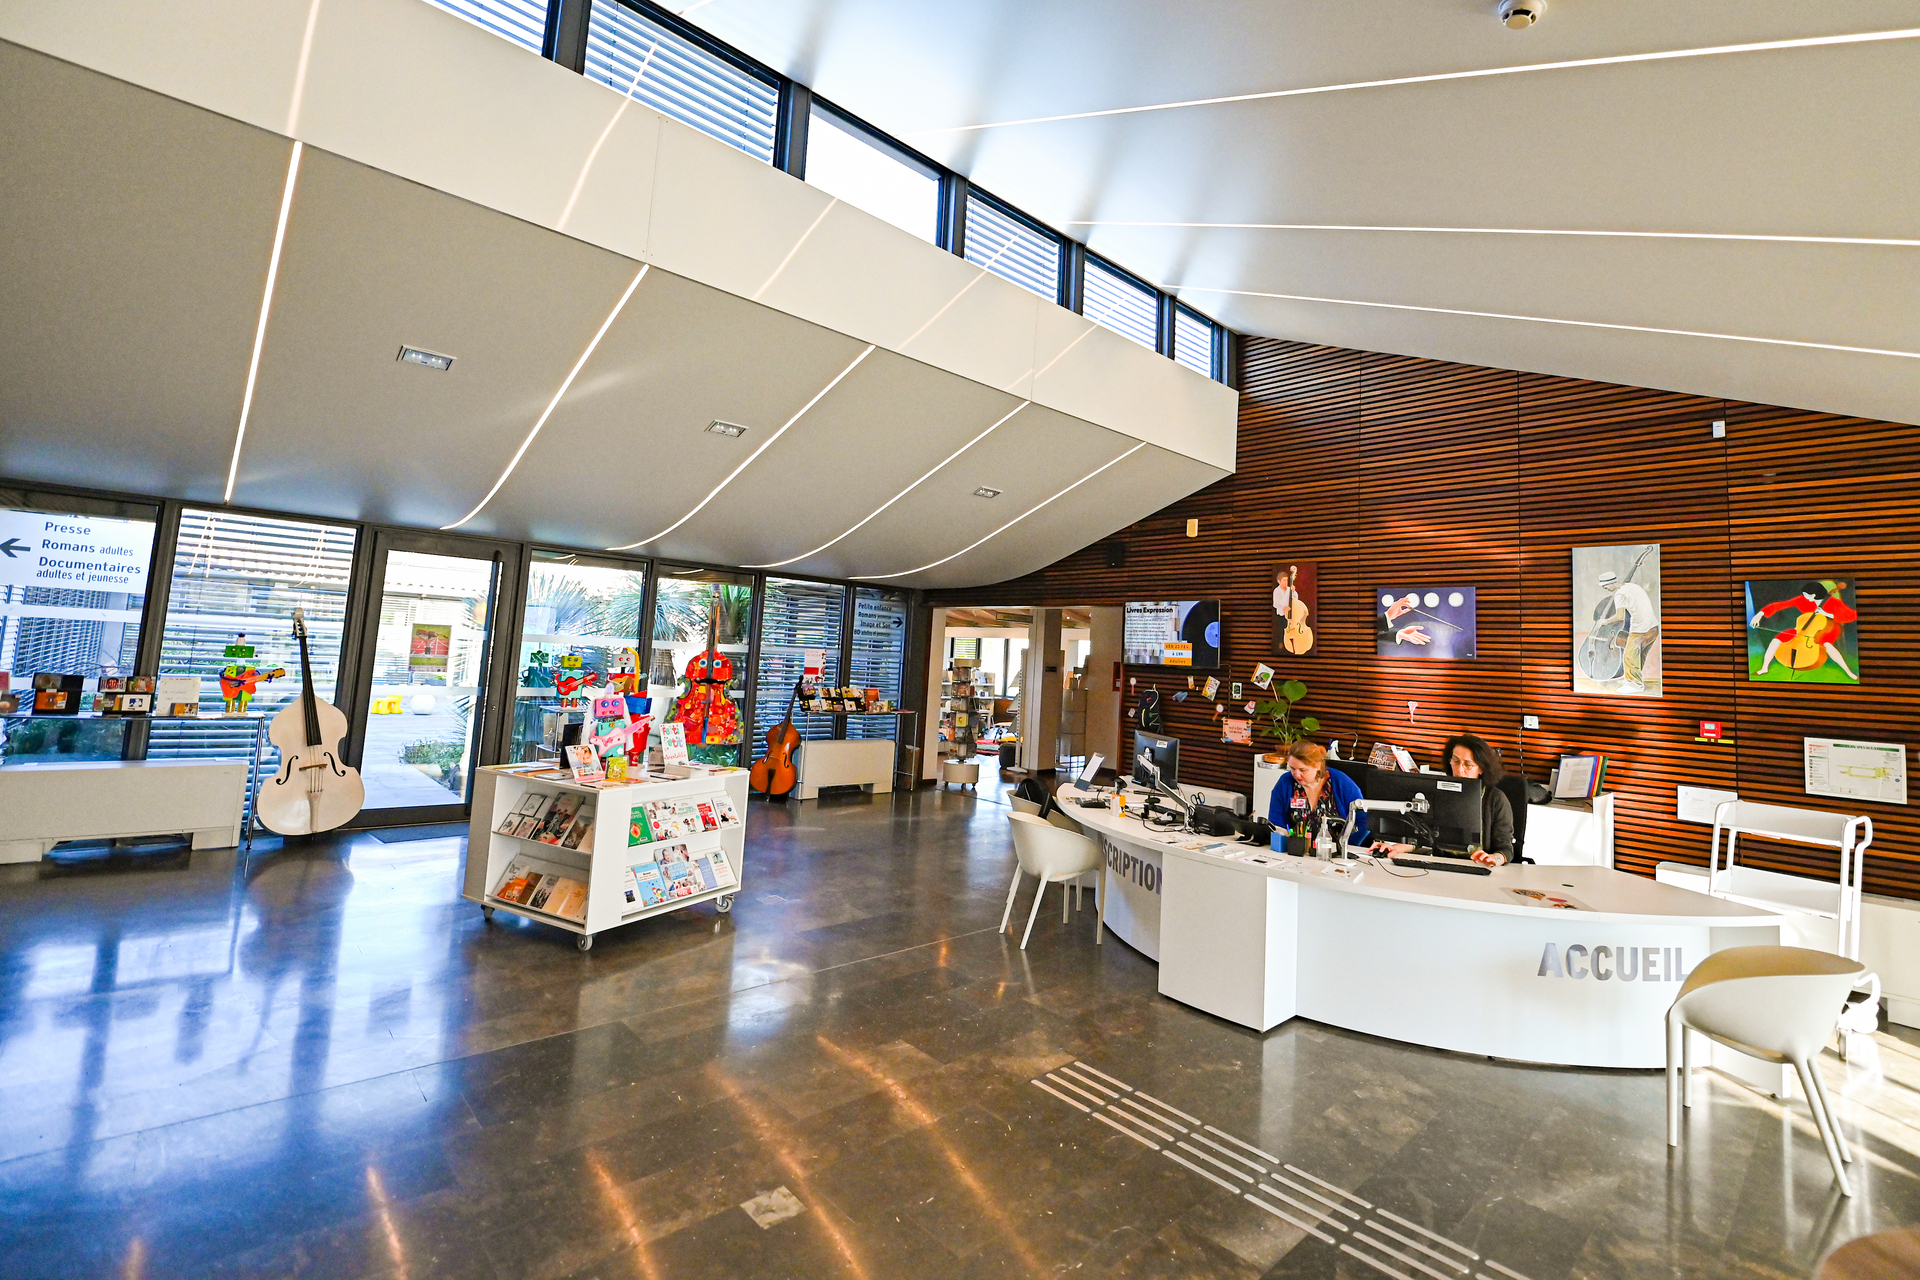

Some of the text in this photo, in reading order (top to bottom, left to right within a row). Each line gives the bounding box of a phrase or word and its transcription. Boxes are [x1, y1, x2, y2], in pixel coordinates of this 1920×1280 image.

[44, 521, 91, 536] Presse
[41, 539, 134, 557] Romans adultes
[38, 556, 141, 574] Documentaires
[36, 568, 129, 584] adultes et jeunesse
[1126, 606, 1174, 615] Livres Expression
[854, 628, 861, 636] BD
[1537, 942, 1690, 982] ACCUEIL
